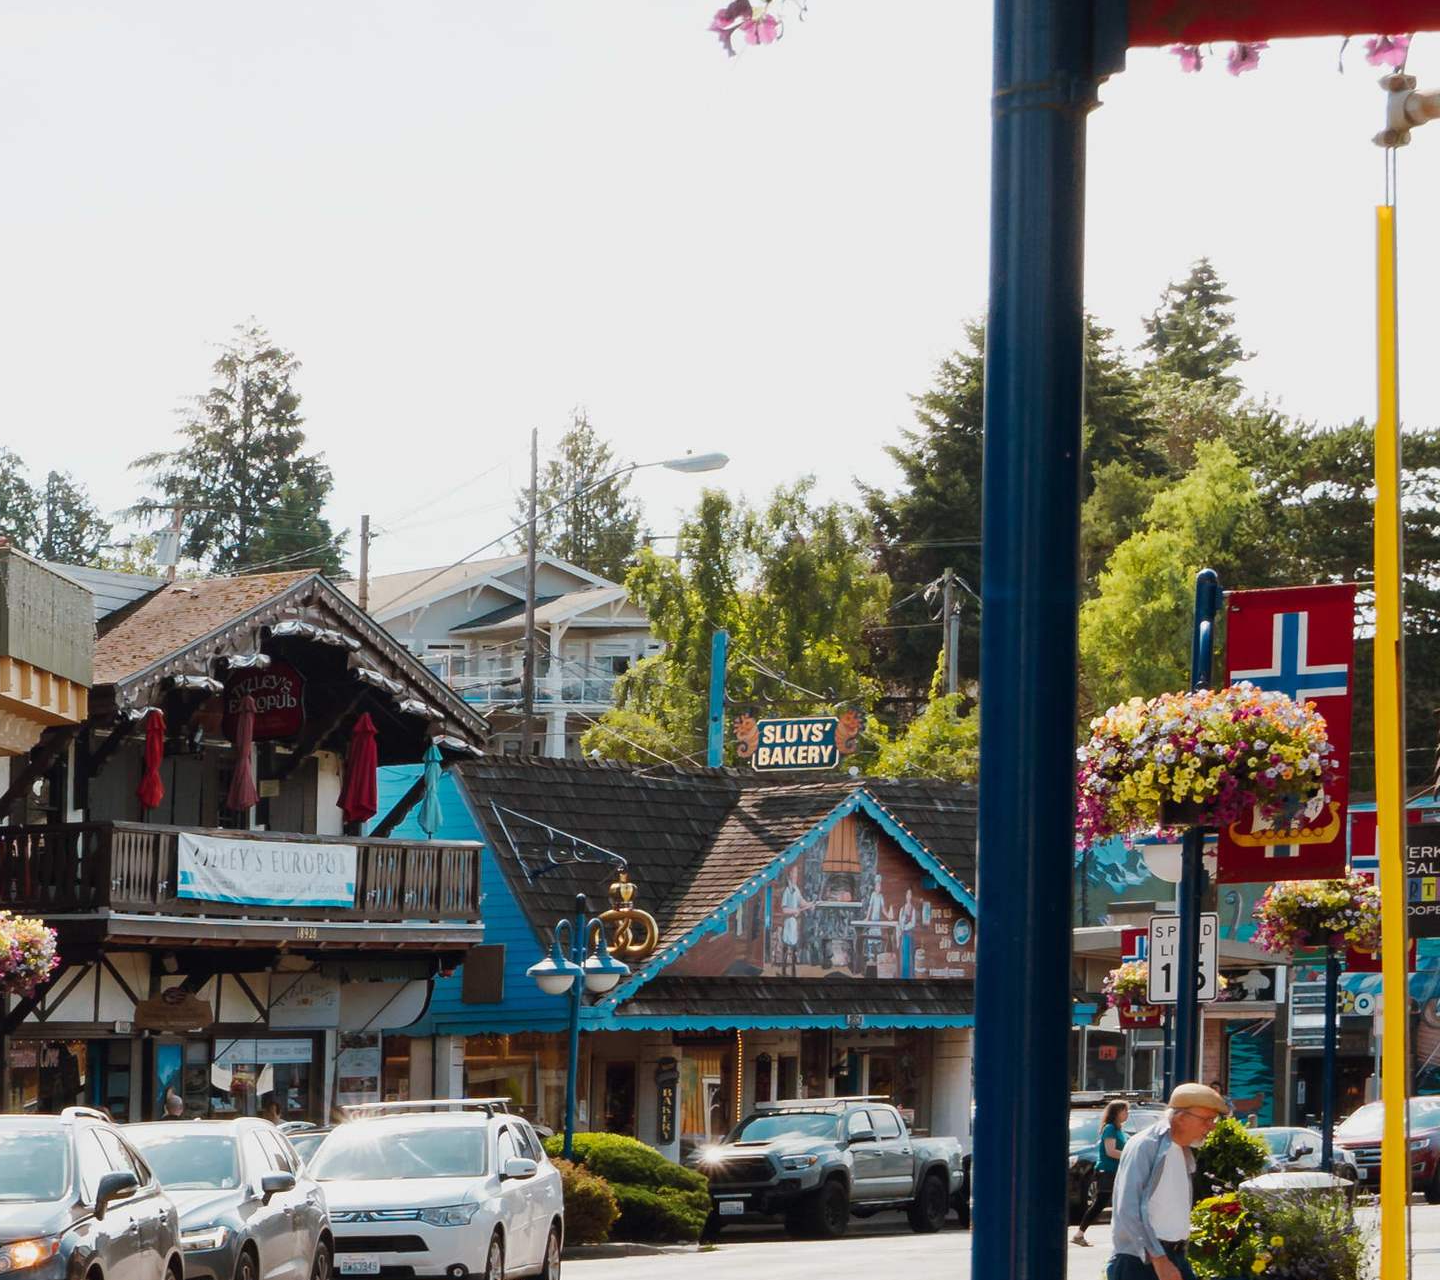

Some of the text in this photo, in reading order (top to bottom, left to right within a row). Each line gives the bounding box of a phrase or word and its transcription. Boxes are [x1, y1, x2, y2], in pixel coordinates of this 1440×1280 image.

[762, 723, 832, 744] SLUYS'
[758, 745, 833, 765] BAKERY
[1155, 925, 1212, 939] SPD
[1161, 943, 1204, 957] LIT
[663, 1087, 674, 1140] BAKERY
